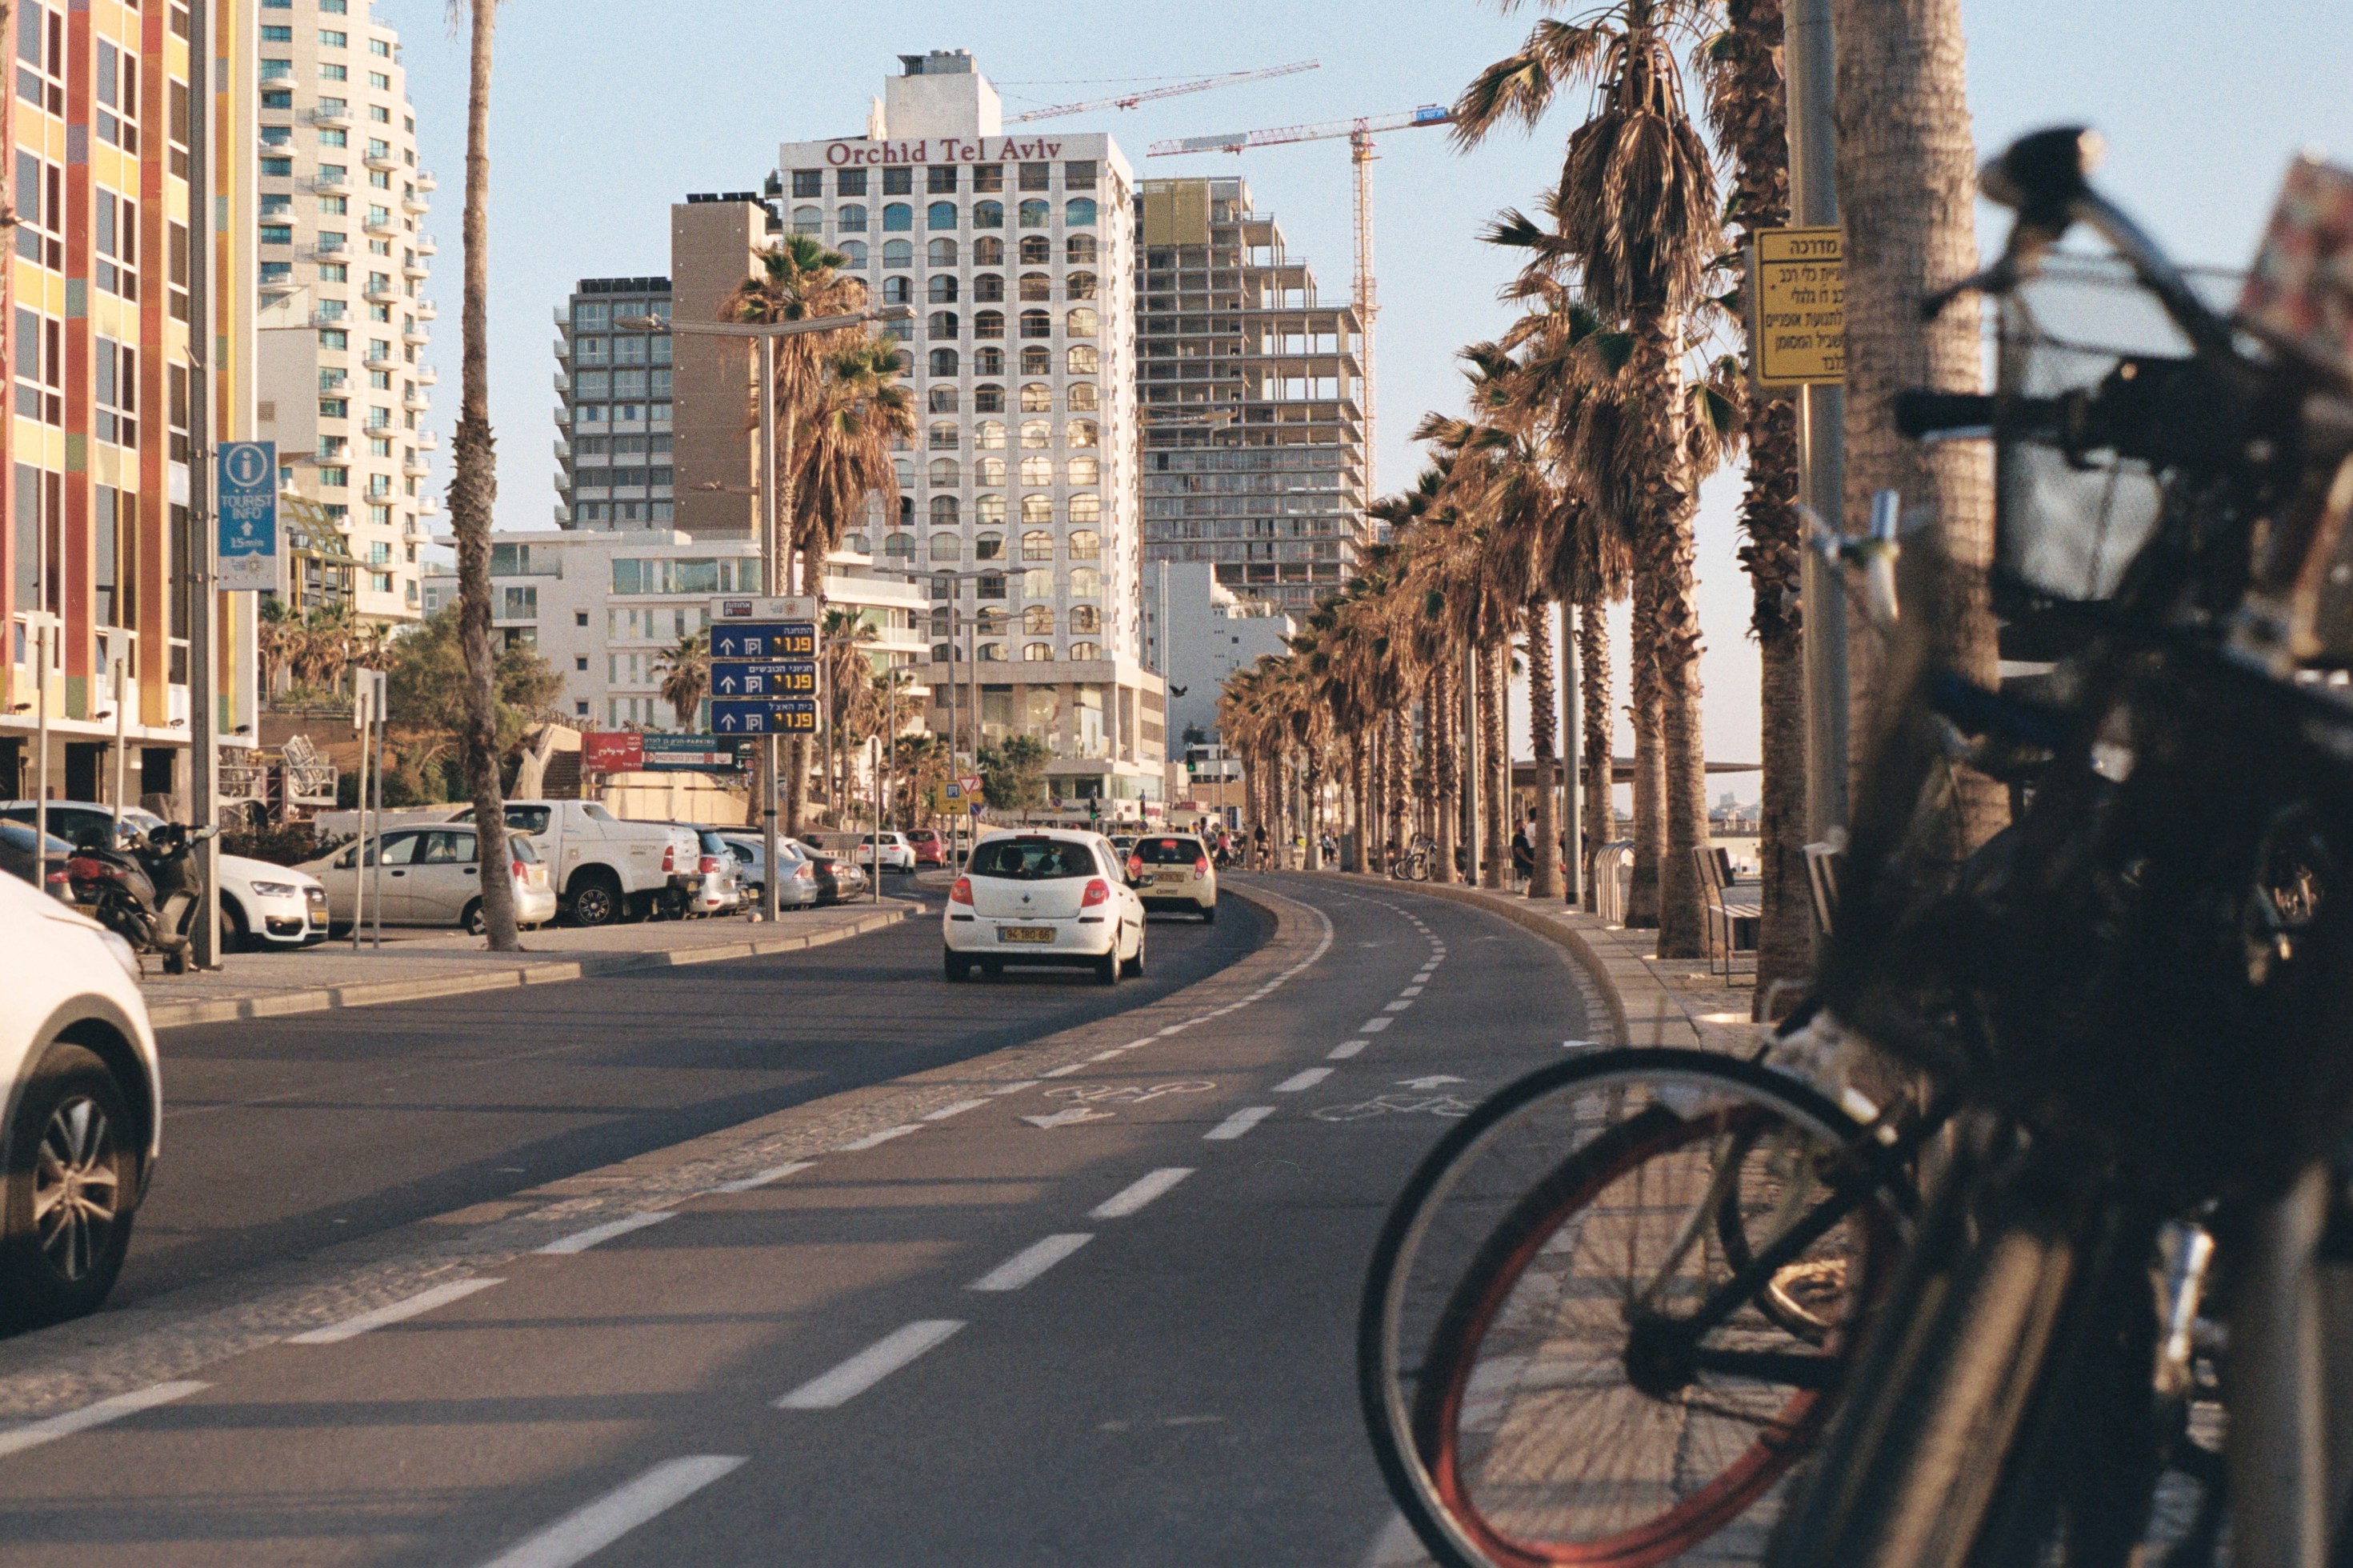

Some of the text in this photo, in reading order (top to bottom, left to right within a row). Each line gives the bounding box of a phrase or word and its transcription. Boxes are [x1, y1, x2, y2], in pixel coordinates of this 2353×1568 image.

[826, 137, 1062, 166] Orchid Tel Aviv
[222, 494, 272, 507] TOURIST
[233, 507, 262, 519] INFO
[774, 637, 811, 652] פנוי
[774, 674, 811, 690] פנוי
[775, 713, 812, 728] פנוי
